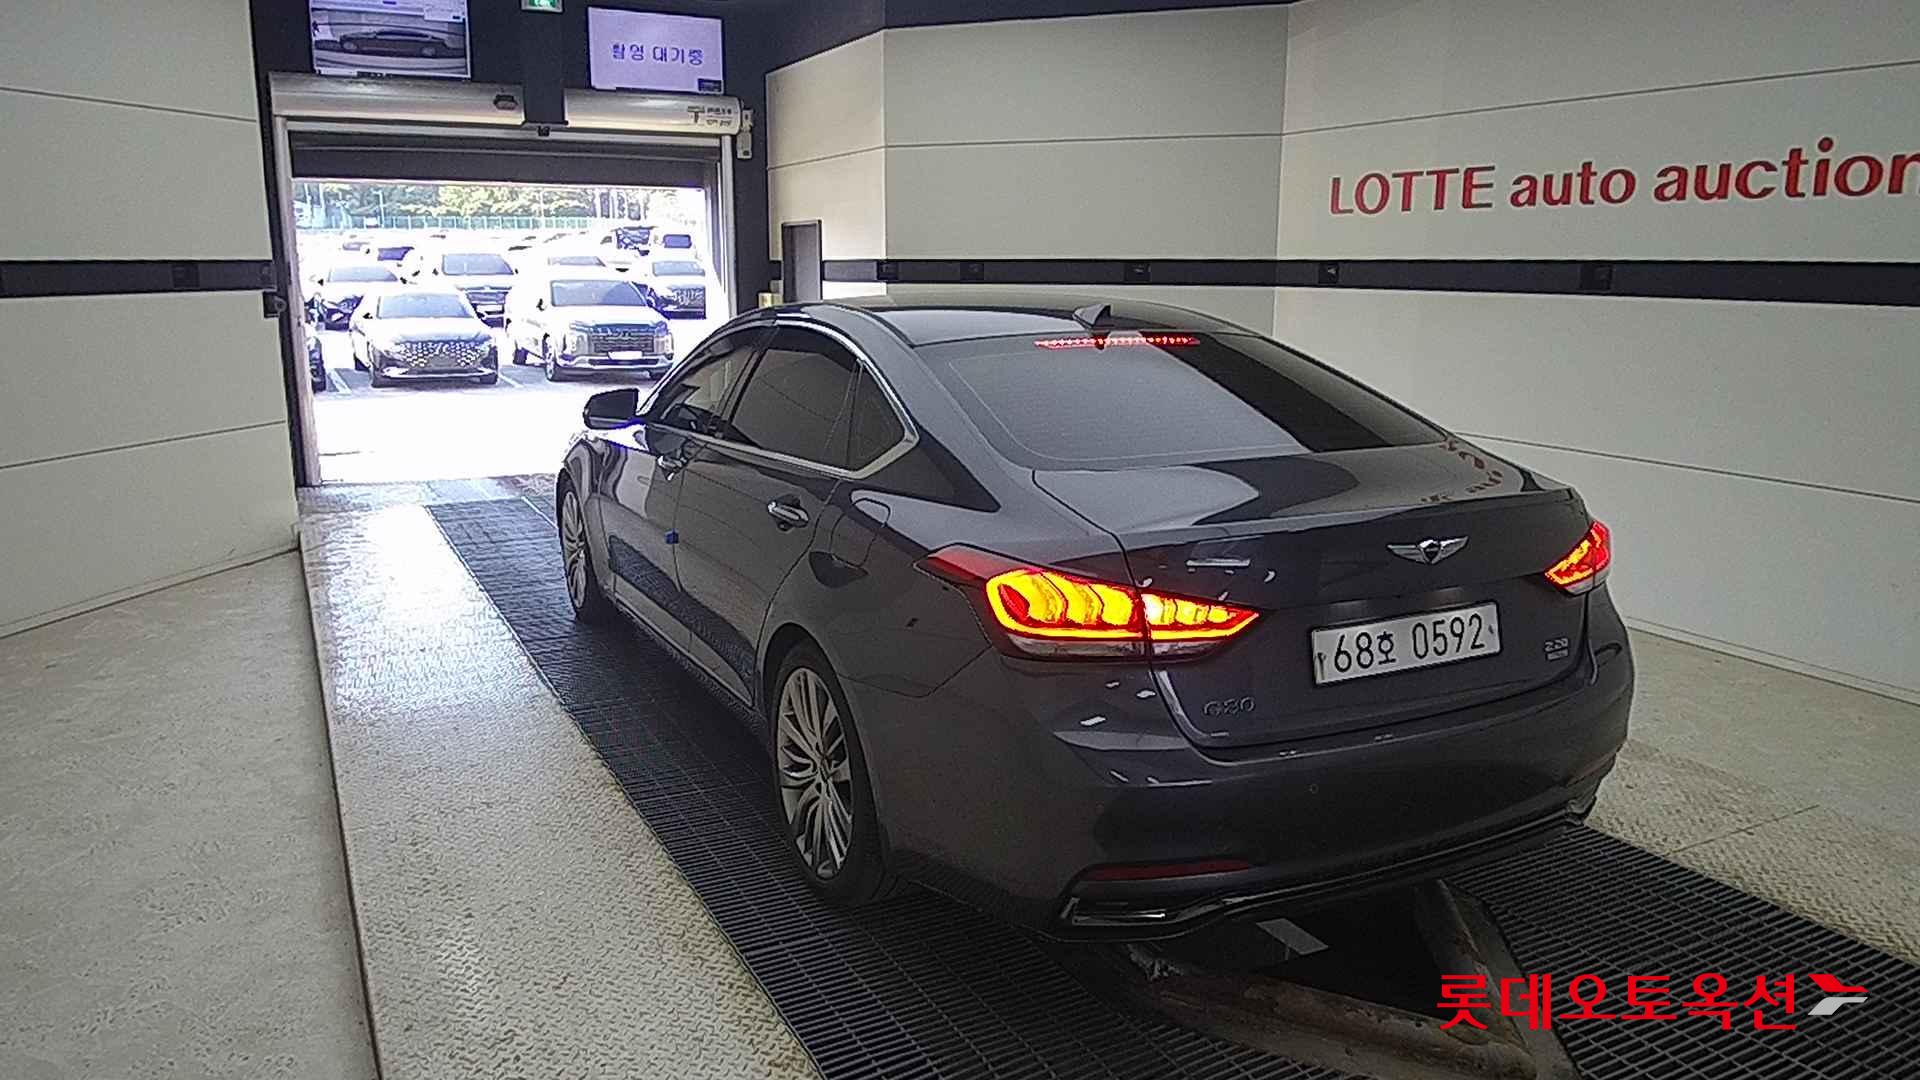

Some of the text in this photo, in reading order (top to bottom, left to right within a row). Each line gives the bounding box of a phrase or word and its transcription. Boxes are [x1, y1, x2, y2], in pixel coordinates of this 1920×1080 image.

[652, 45, 704, 67] 대기중
[1330, 166, 1496, 215] LOTTE
[1510, 161, 1637, 208] auto
[1333, 612, 1487, 674] 68호 0592
